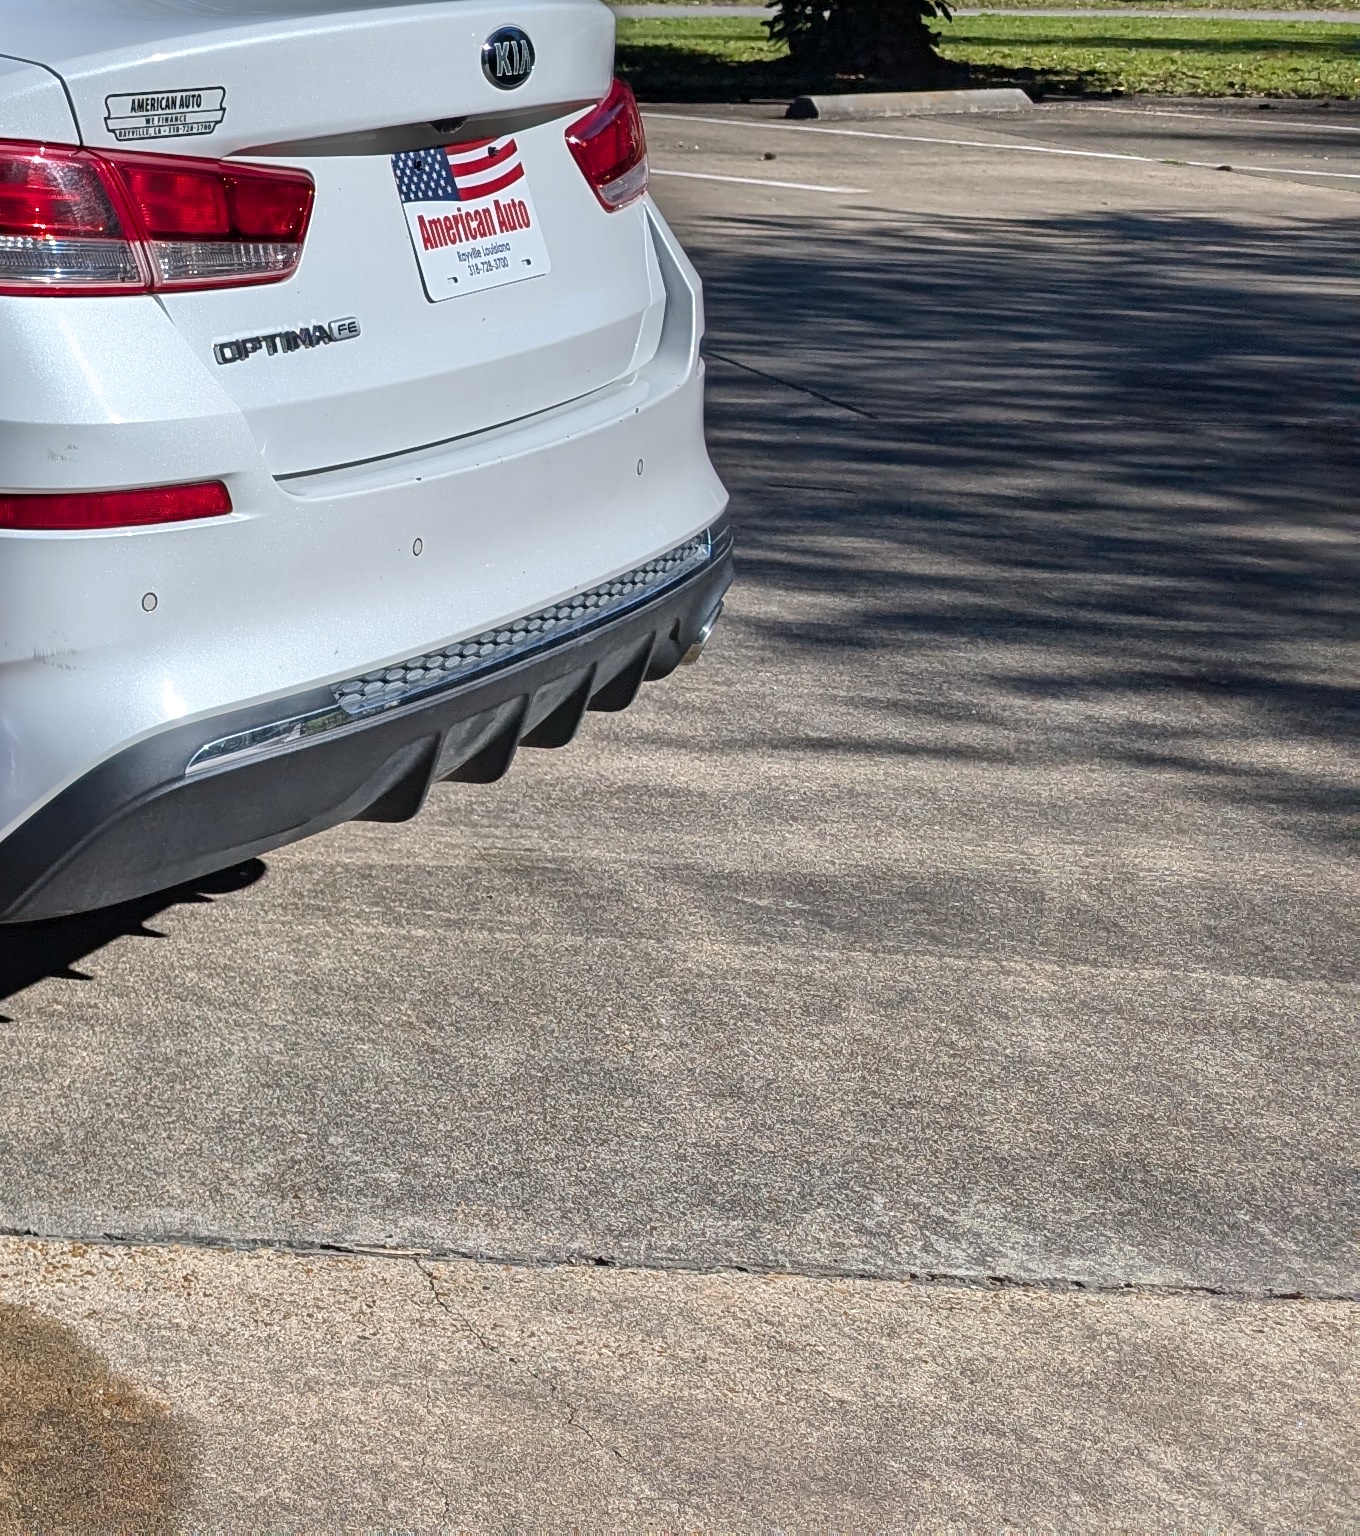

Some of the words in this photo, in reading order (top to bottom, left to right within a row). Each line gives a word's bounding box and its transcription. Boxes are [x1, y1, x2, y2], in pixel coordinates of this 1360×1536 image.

[493, 39, 531, 77] KIA
[130, 95, 178, 113] AMERICAN
[178, 93, 203, 110] AUTO
[145, 116, 155, 125] WE
[157, 114, 188, 125] FINANCE
[153, 126, 162, 135] LA
[416, 206, 498, 251] American
[493, 198, 532, 234] Auto
[456, 247, 482, 264] Rayville
[481, 241, 511, 257] Louisiana
[467, 255, 509, 277] 318-728-3700
[213, 324, 333, 366] OPTIMA
